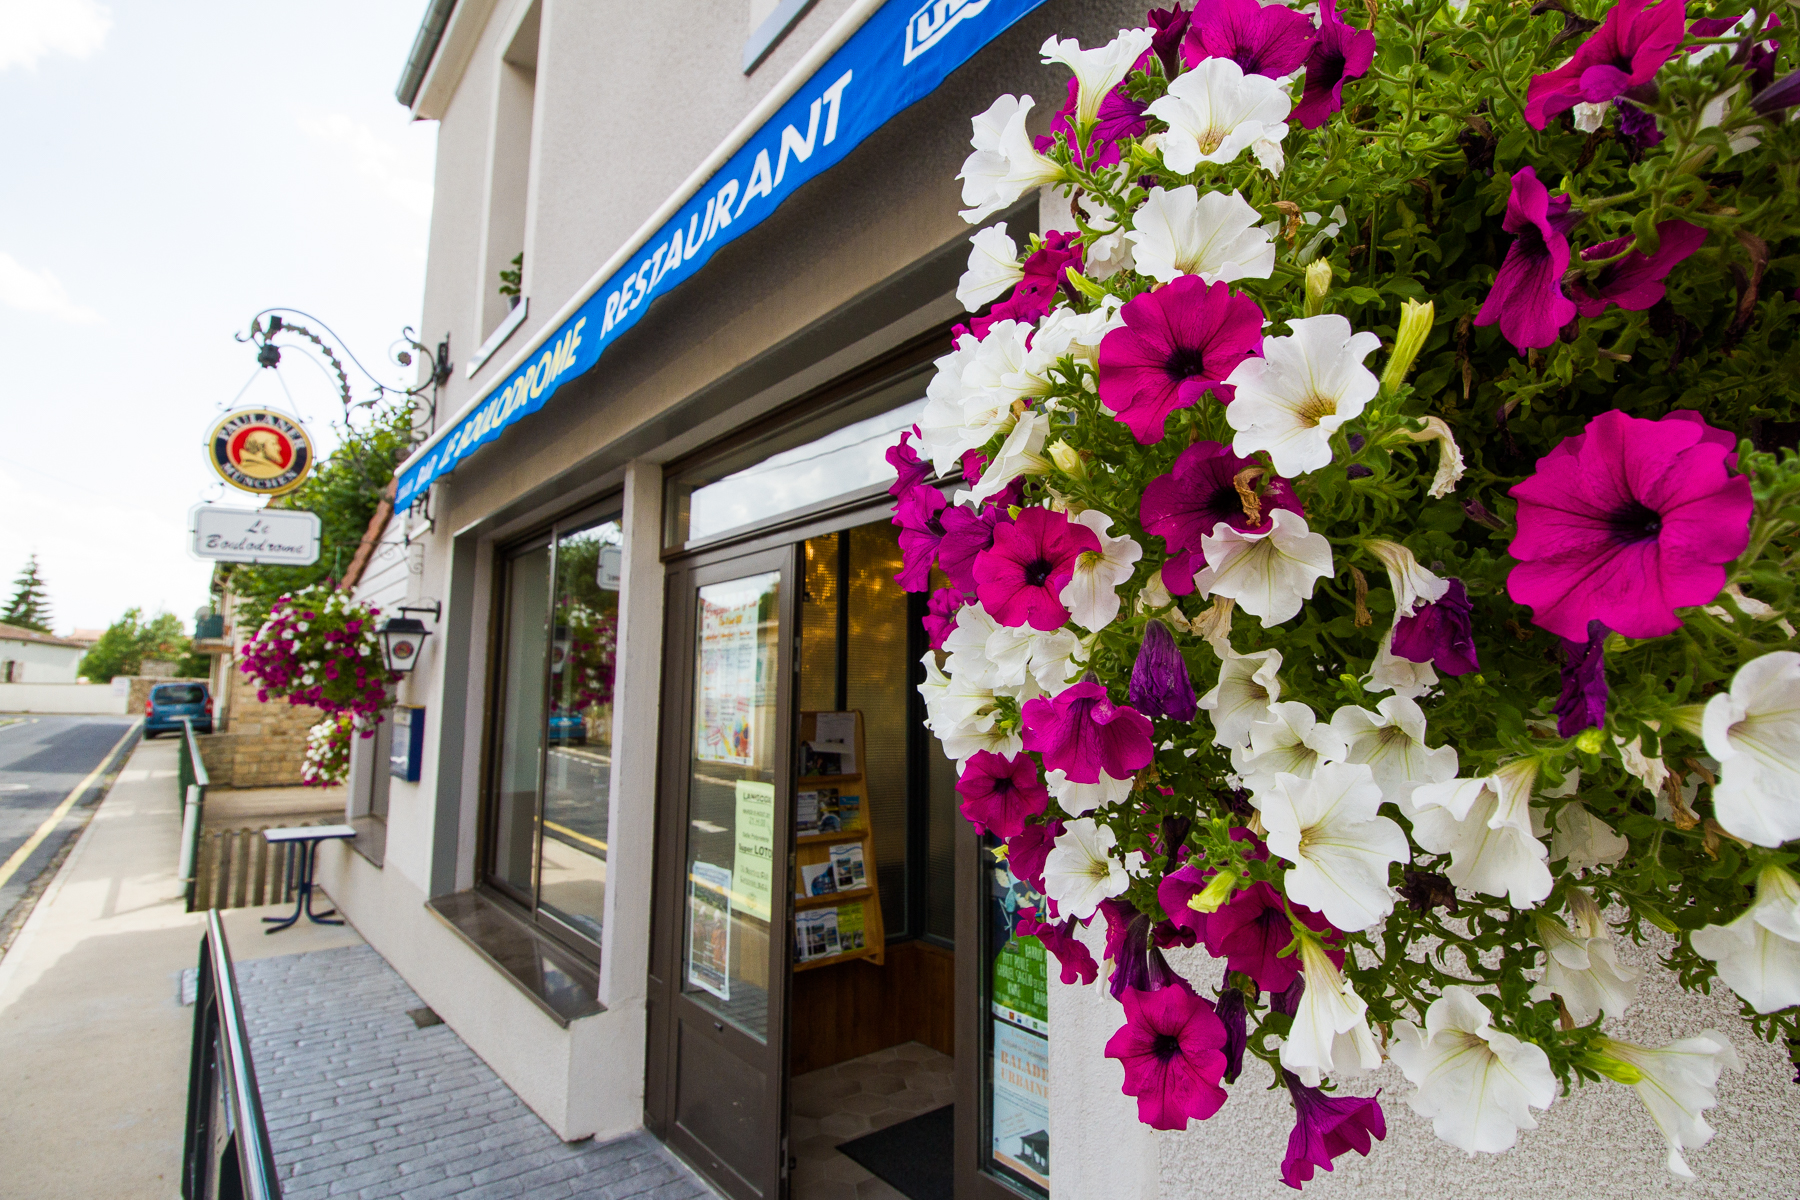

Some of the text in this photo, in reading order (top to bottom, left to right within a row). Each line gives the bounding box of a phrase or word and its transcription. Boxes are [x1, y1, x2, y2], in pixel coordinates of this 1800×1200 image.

[438, 431, 461, 470] LE
[454, 316, 587, 458] BOULODROME
[600, 69, 853, 341] RESTAURANT
[217, 413, 307, 450] PAULANER
[246, 518, 270, 534] Le
[205, 534, 304, 554] Boulodrome
